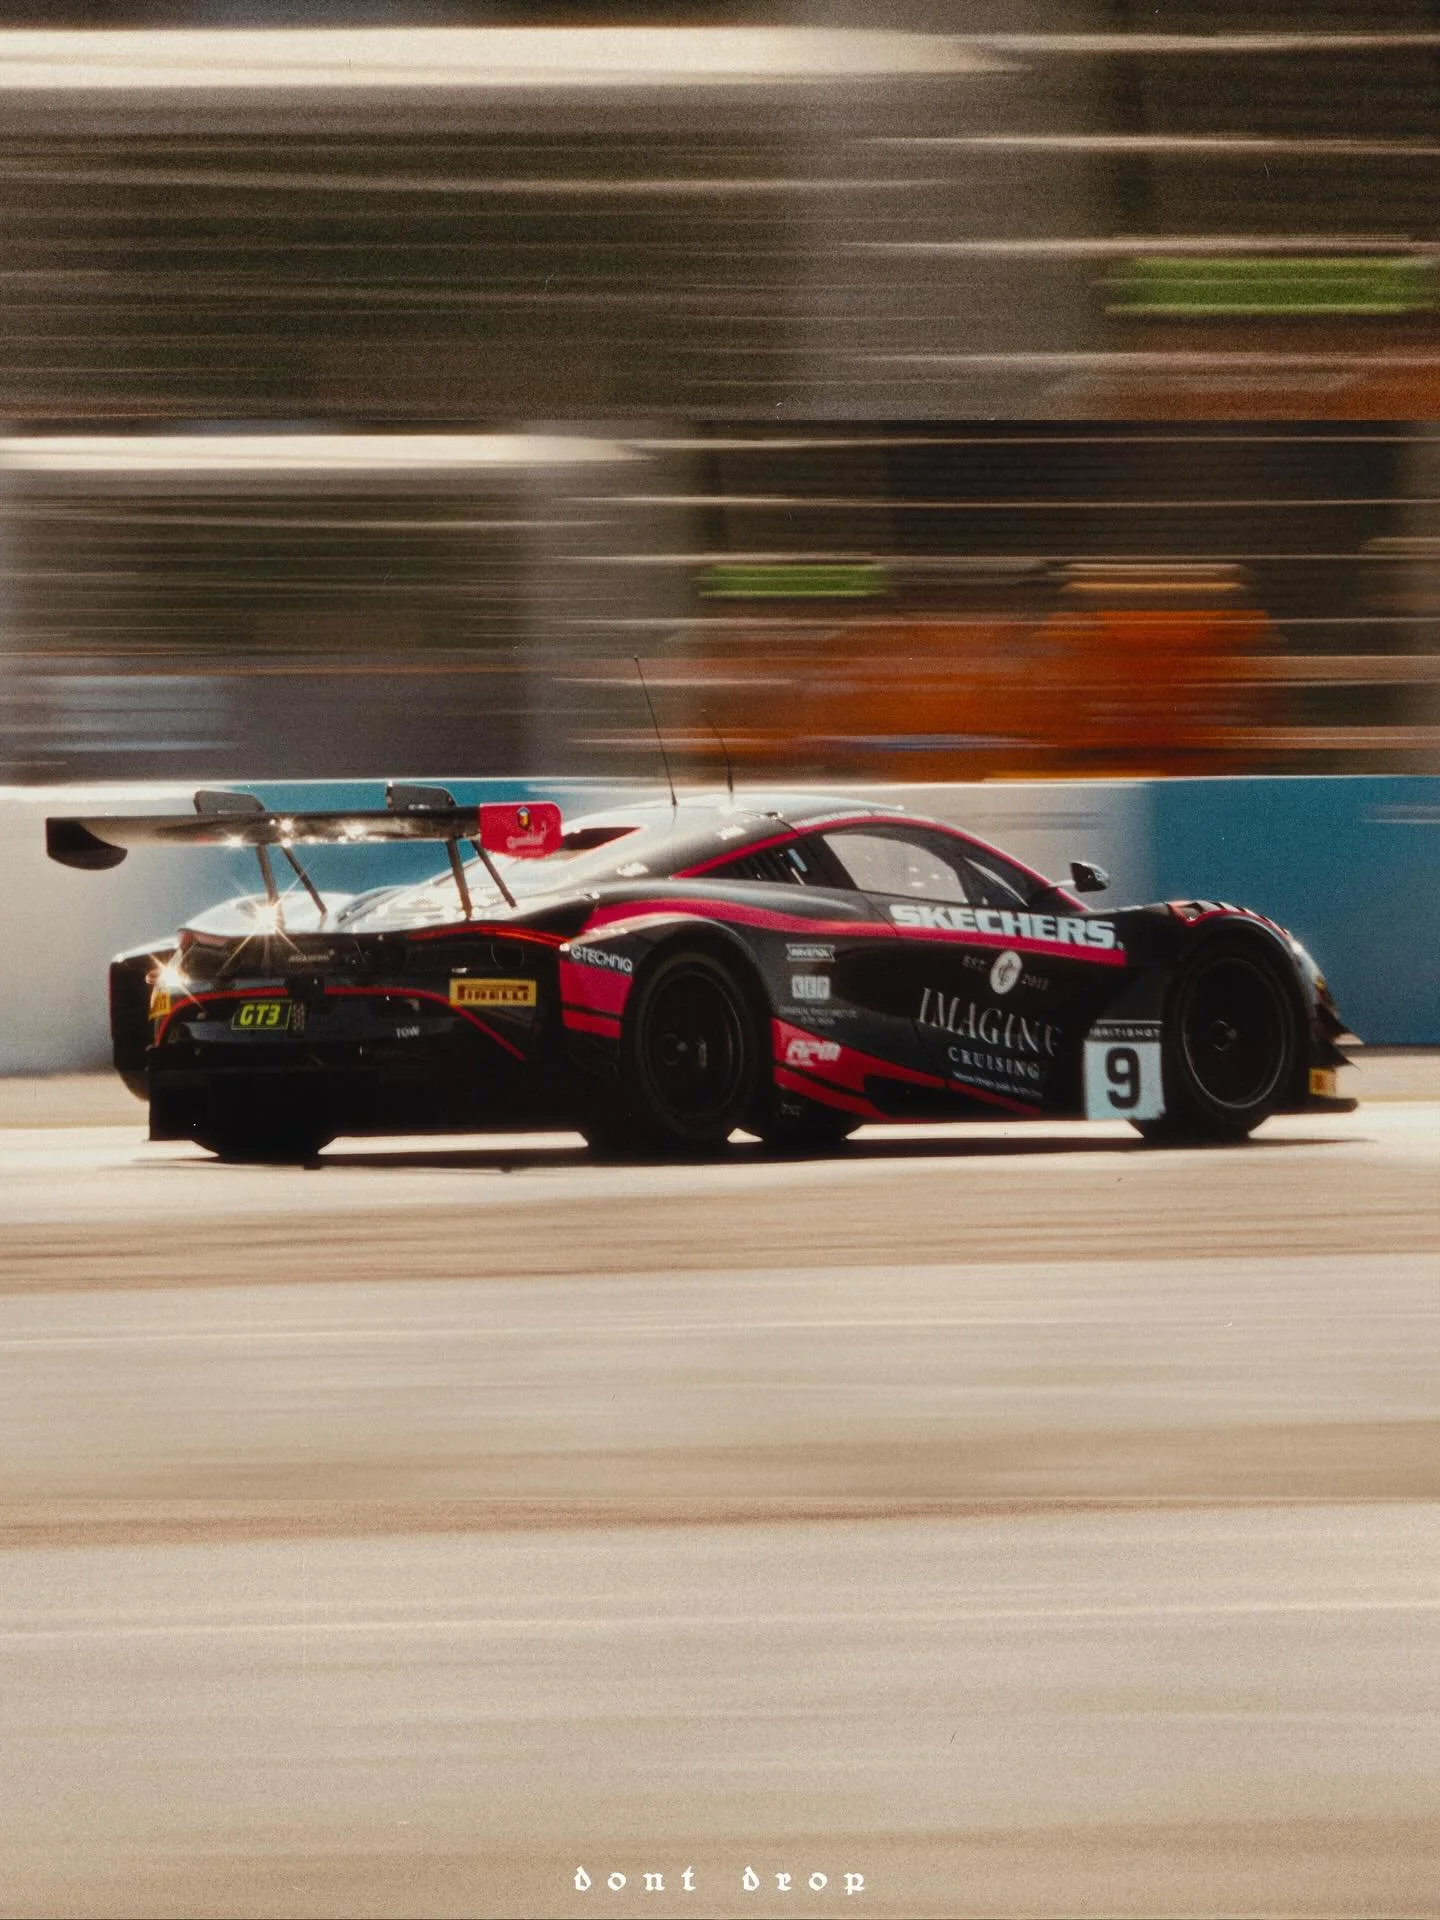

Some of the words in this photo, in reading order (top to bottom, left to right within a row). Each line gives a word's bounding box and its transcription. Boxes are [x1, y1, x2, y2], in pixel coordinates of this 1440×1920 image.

[457, 985, 529, 1000] PIRELLI
[239, 1003, 281, 1025] GT3
[948, 1047, 1040, 1080] CRUISING
[1106, 1047, 1140, 1109] 9
